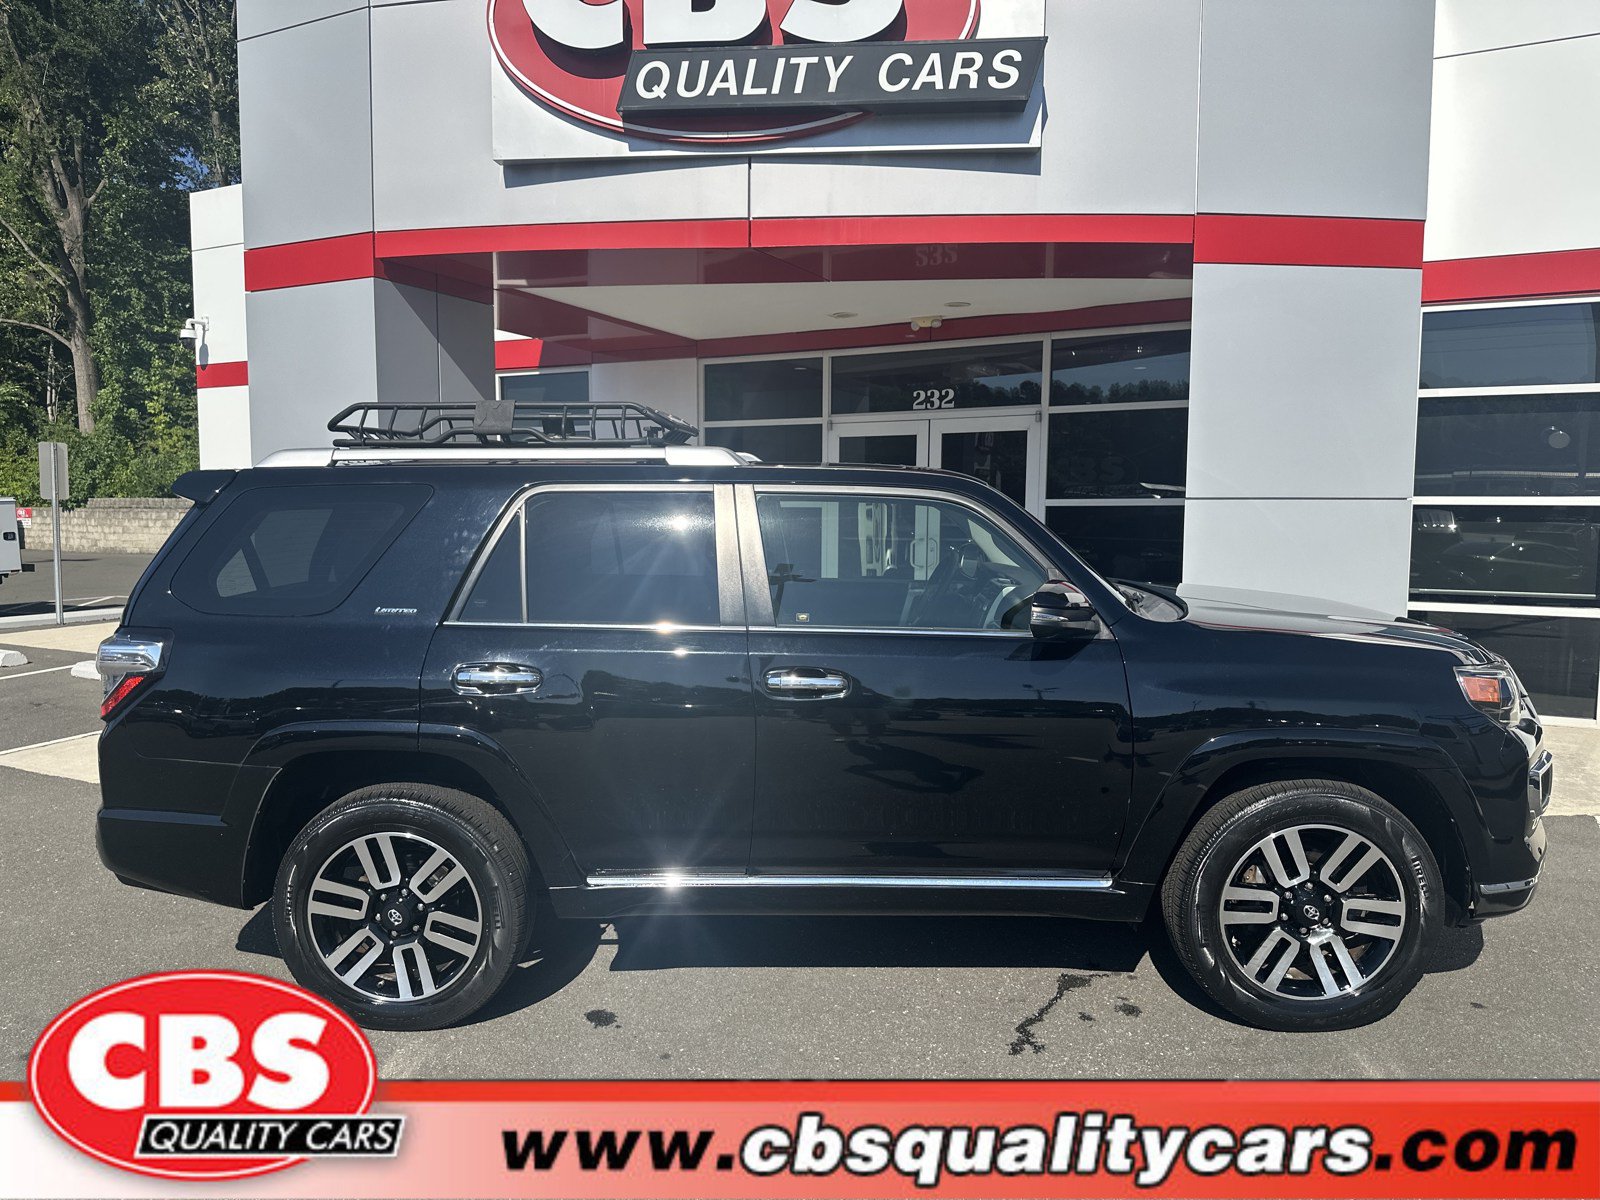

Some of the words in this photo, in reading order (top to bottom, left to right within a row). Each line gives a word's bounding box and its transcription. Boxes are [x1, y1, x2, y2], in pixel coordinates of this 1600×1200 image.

[635, 55, 854, 99] QUALITY
[878, 48, 1022, 92] CARS
[912, 388, 955, 410] 232
